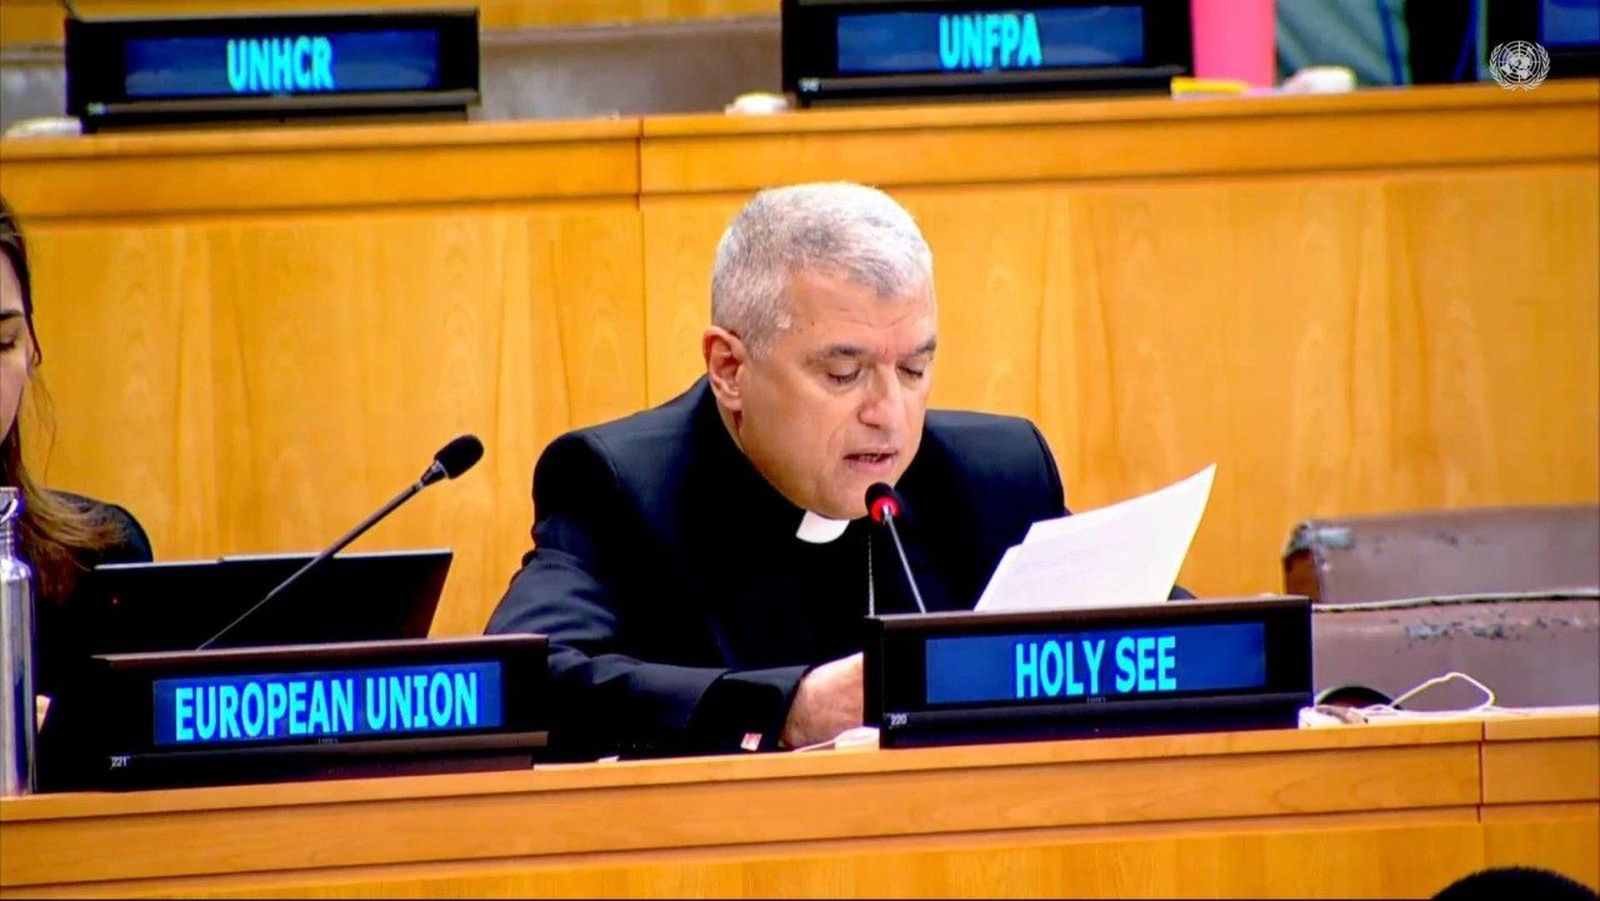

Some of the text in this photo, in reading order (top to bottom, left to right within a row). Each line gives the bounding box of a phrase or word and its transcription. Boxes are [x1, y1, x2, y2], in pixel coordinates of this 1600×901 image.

[227, 36, 334, 92] UNHCR
[938, 12, 1042, 69] UNFPA
[1015, 636, 1177, 698] HOLY SEE
[175, 672, 477, 741] EUROPEAN UNION
